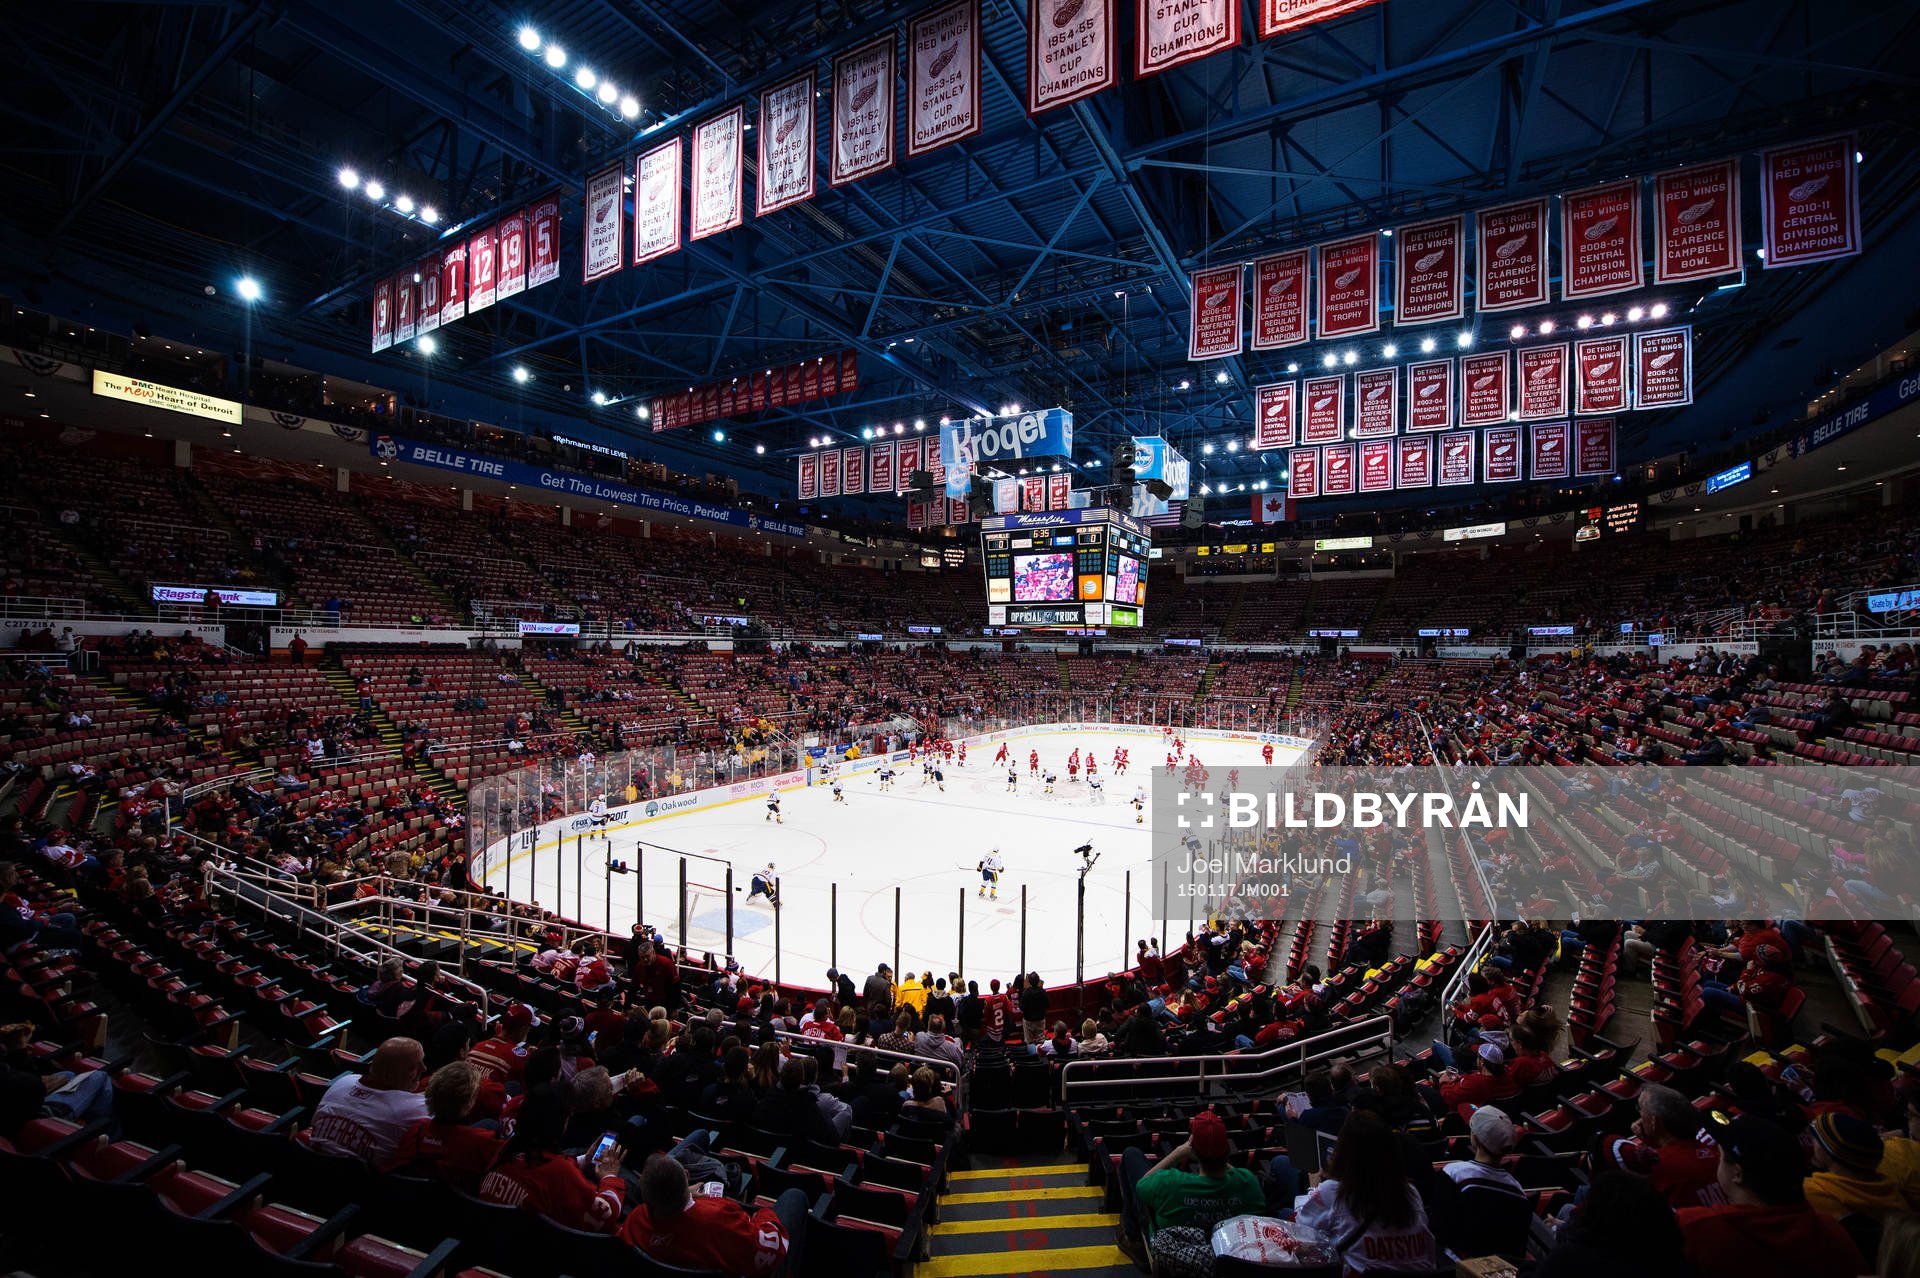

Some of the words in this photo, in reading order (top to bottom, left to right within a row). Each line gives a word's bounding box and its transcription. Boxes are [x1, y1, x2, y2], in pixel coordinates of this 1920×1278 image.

[922, 10, 963, 37] DETROIT
[1174, 13, 1200, 32] CUP
[918, 41, 936, 52] RED
[941, 23, 968, 42] WINGS
[1049, 19, 1094, 47] 1954-55
[1151, 23, 1223, 58] CHAMPIONS
[1046, 33, 1096, 63] STANLEY
[847, 54, 879, 72] DETROIT
[1060, 57, 1082, 74] CUP
[842, 75, 857, 87] RED
[862, 61, 886, 79] WINGS
[1040, 67, 1103, 95] CHAMPIONS
[925, 71, 962, 96] 1953-54
[923, 85, 965, 110] STANLEY
[848, 109, 879, 128] 1951-52
[935, 105, 952, 120] CUP
[842, 122, 881, 141] STANLEY
[917, 113, 970, 140] CHAMPIONS
[854, 140, 871, 153] CUP
[840, 148, 885, 172] CHAMPIONS
[1776, 169, 1800, 180] RED
[1806, 160, 1841, 174] WINGS
[1574, 210, 1593, 219] RED
[1599, 203, 1629, 215] WINGS
[1789, 201, 1830, 215] 2010-11
[1492, 213, 1532, 226] DETROIT
[1784, 212, 1836, 228] CENTRAL
[1411, 229, 1448, 242] DETROIT
[1487, 228, 1505, 237] RED
[1509, 222, 1536, 232] WINGS
[1783, 224, 1838, 240] DIVISION
[538, 220, 550, 256] 5
[1407, 244, 1423, 253] RED
[1428, 238, 1453, 249] WINGS
[1580, 237, 1624, 252] 2008-09
[1777, 235, 1844, 253] CHAMPIONS
[502, 234, 520, 273] 19
[1331, 247, 1364, 258] DETROIT
[1580, 249, 1624, 263] CENTRAL
[474, 250, 492, 286] 12
[1265, 259, 1298, 271] DETROIT
[1327, 260, 1342, 268] RED
[1346, 255, 1368, 265] WINGS
[1492, 256, 1532, 268] 2007-08
[1580, 260, 1625, 275] DIVISION
[1262, 272, 1276, 280] RED
[1280, 267, 1301, 277] WINGS
[1411, 271, 1448, 283] 2007-08
[1488, 265, 1536, 279] CLARENCE
[1575, 270, 1630, 286] CHAMPIONS
[451, 266, 456, 297] 1
[1411, 282, 1447, 293] CENTRAL
[1488, 276, 1536, 290] CAMPBELL
[421, 276, 436, 310] 10
[1265, 294, 1297, 304] 2007-08
[1331, 290, 1364, 301] 2007-08
[1410, 291, 1448, 303] DIVISION
[1500, 289, 1524, 298] BOWL
[401, 288, 409, 318] 7
[1265, 301, 1297, 311] WESTERN
[1405, 301, 1453, 314] CHAMPIONS
[378, 299, 386, 328] 9
[1261, 307, 1301, 320] CONFERENCE
[1333, 311, 1362, 321] TROPHY
[1265, 317, 1296, 327] REGULAR
[1267, 325, 1294, 334] SEASON
[1260, 332, 1301, 343] CHAMPIONS
[1646, 337, 1677, 346] DETROIT
[1660, 343, 1682, 351] WINGS
[132, 380, 153, 389] DMC
[1647, 376, 1680, 384] CENTRAL
[104, 382, 121, 390] The
[124, 386, 154, 398] new
[157, 393, 184, 404] Heart
[201, 403, 232, 415] Detroit
[1643, 391, 1683, 400] CHAMPIONS
[1813, 416, 1842, 445] BELLE
[1845, 402, 1869, 426] TIRE
[952, 411, 1049, 464] Kroger
[592, 445, 609, 454] SUITE
[610, 450, 627, 459] LEVEL
[413, 448, 465, 468] BELLE
[470, 458, 504, 475] TIRE
[541, 473, 565, 488] Get
[569, 479, 592, 493] The
[595, 484, 637, 503] Lowest
[640, 494, 660, 507] Tire
[663, 499, 691, 514] Price,
[694, 505, 729, 521] Period!
[764, 521, 787, 532] BELLE
[789, 525, 804, 535] TIRE
[1033, 530, 1049, 538] 6:35
[159, 589, 205, 600] Flagsta
[217, 592, 240, 601] ank
[1011, 612, 1041, 622] OFFICIAL
[1055, 611, 1079, 621] TRUCK
[661, 796, 697, 811] Oakwood
[576, 818, 588, 827] FOX
[995, 1008, 1004, 1026] 2
